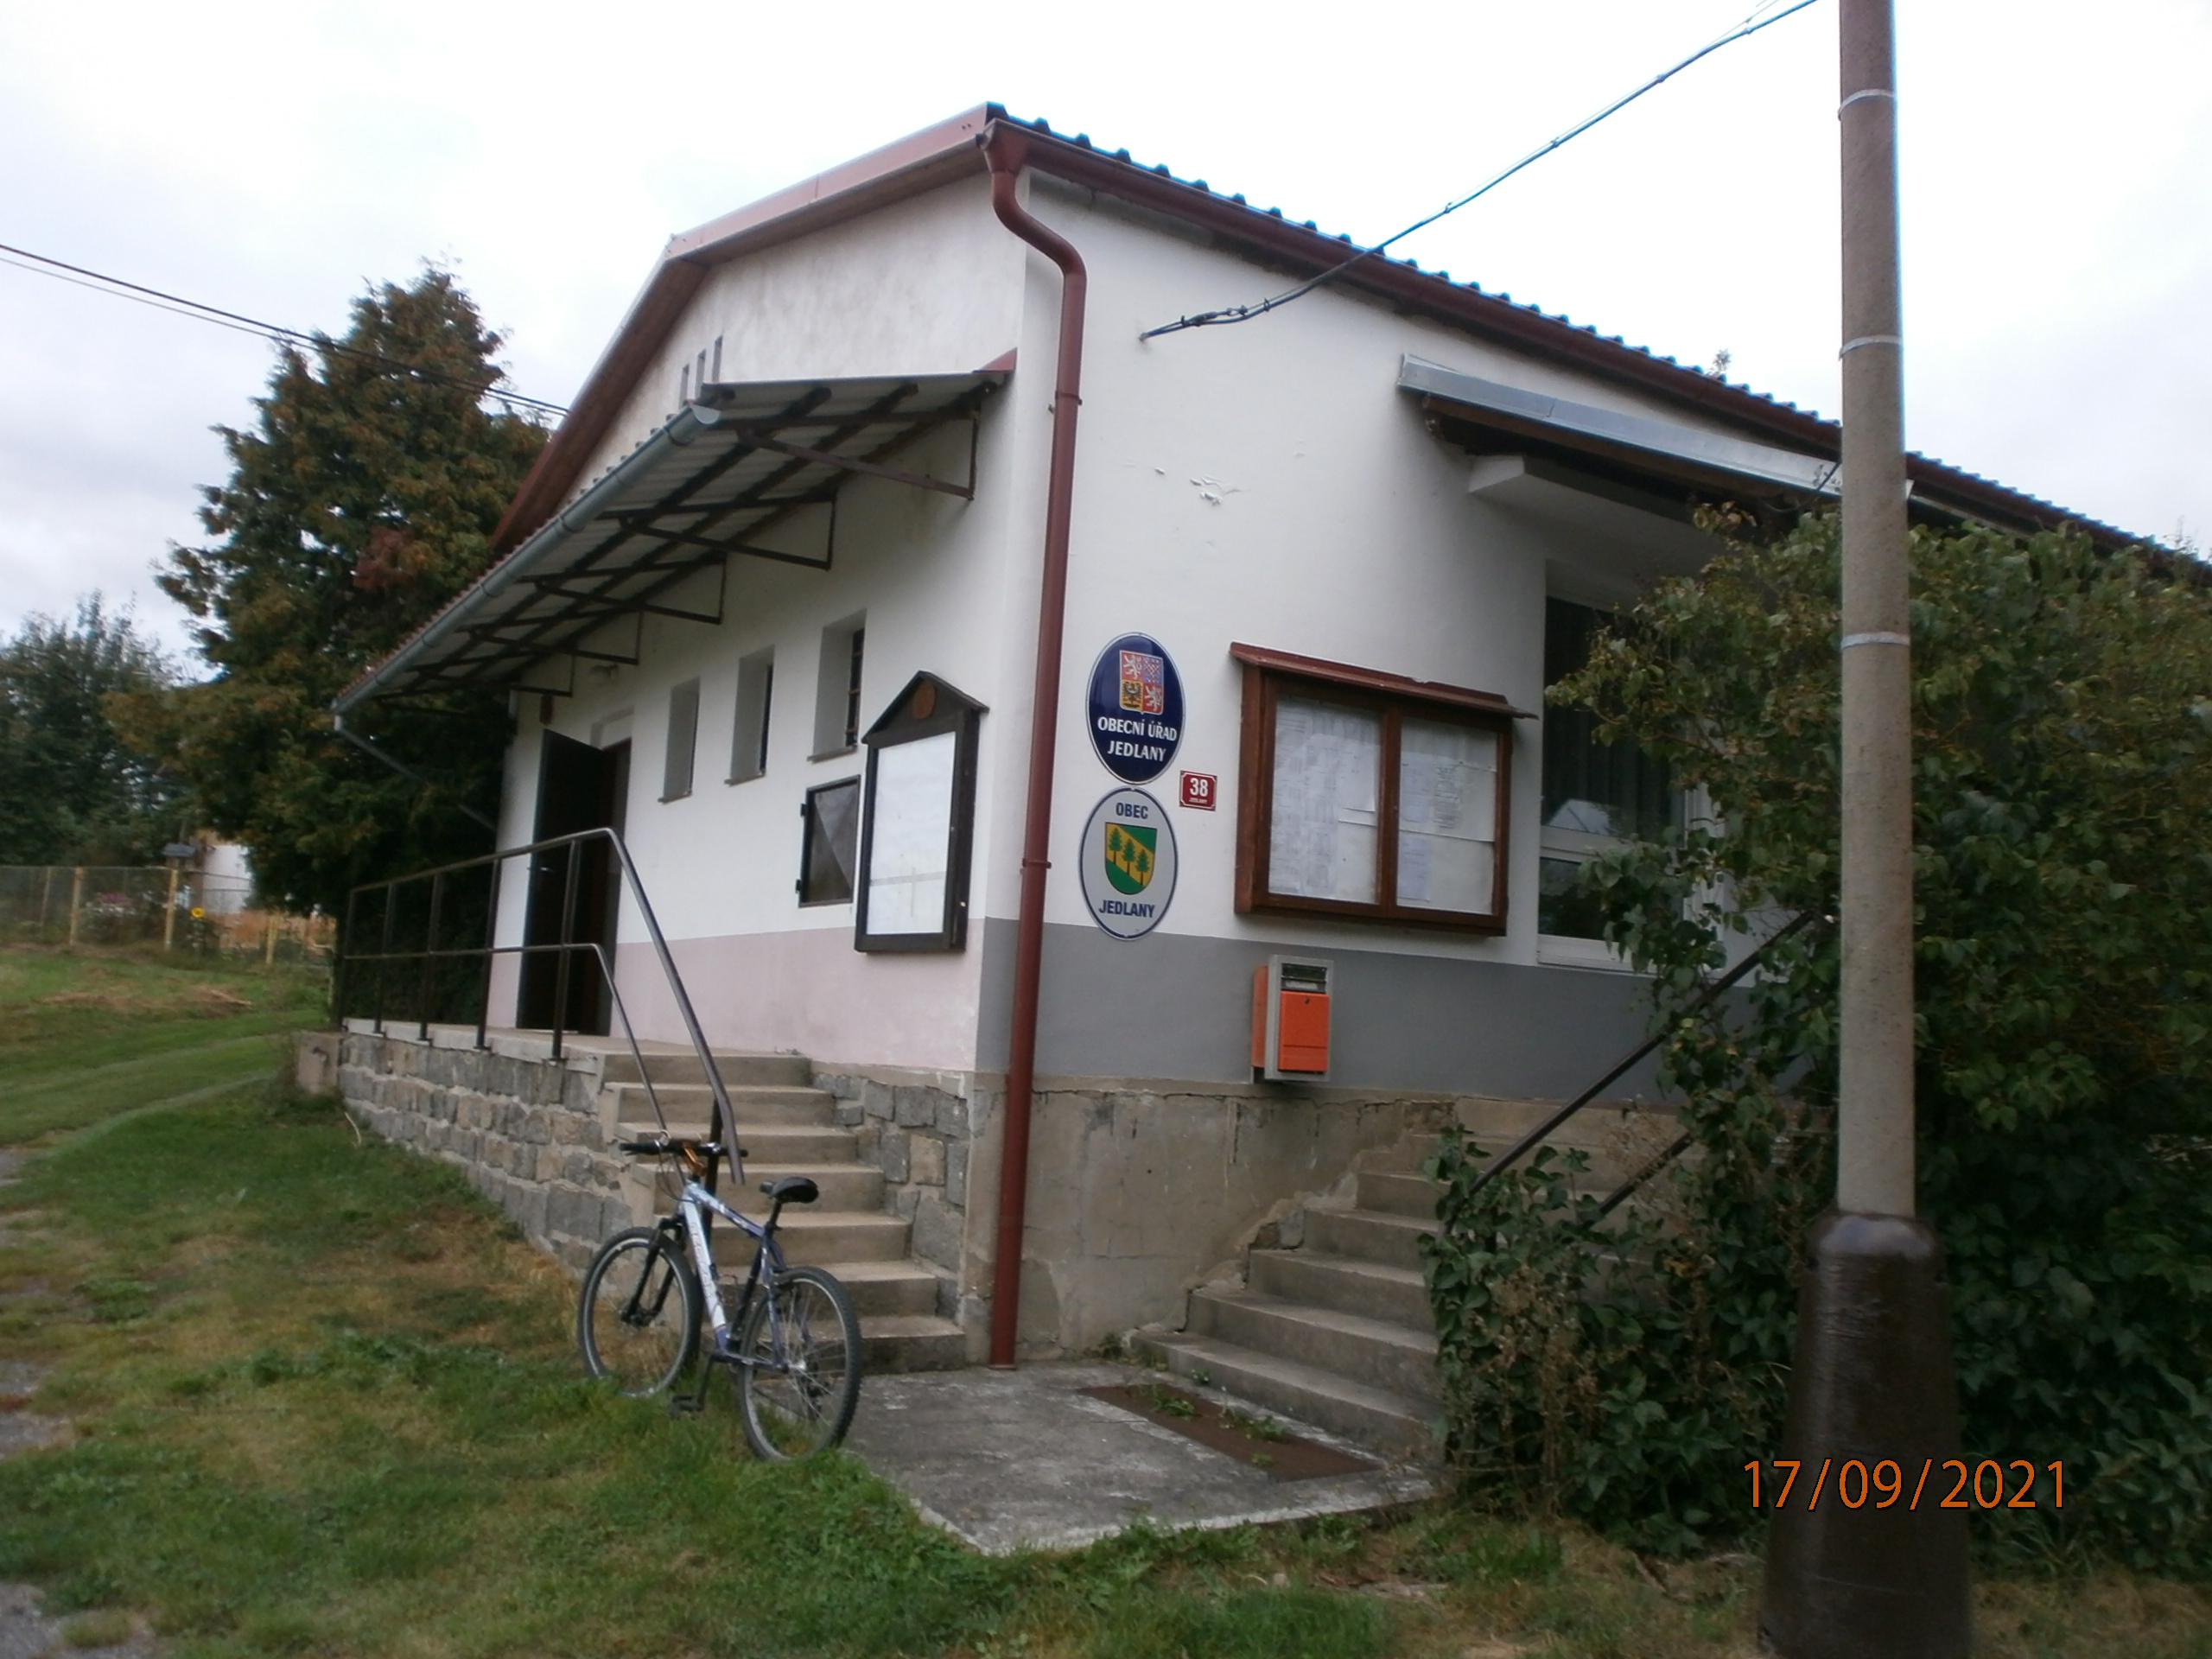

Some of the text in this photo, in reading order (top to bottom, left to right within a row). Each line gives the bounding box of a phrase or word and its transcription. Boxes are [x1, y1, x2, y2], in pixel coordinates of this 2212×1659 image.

[1097, 716, 1178, 741] OBECNÍ ÚŘAD
[1107, 741, 1166, 762] JEDLANY
[1189, 778, 1209, 797] 38
[1116, 802, 1148, 819] OBEC
[1099, 899, 1155, 918] JEDLANY
